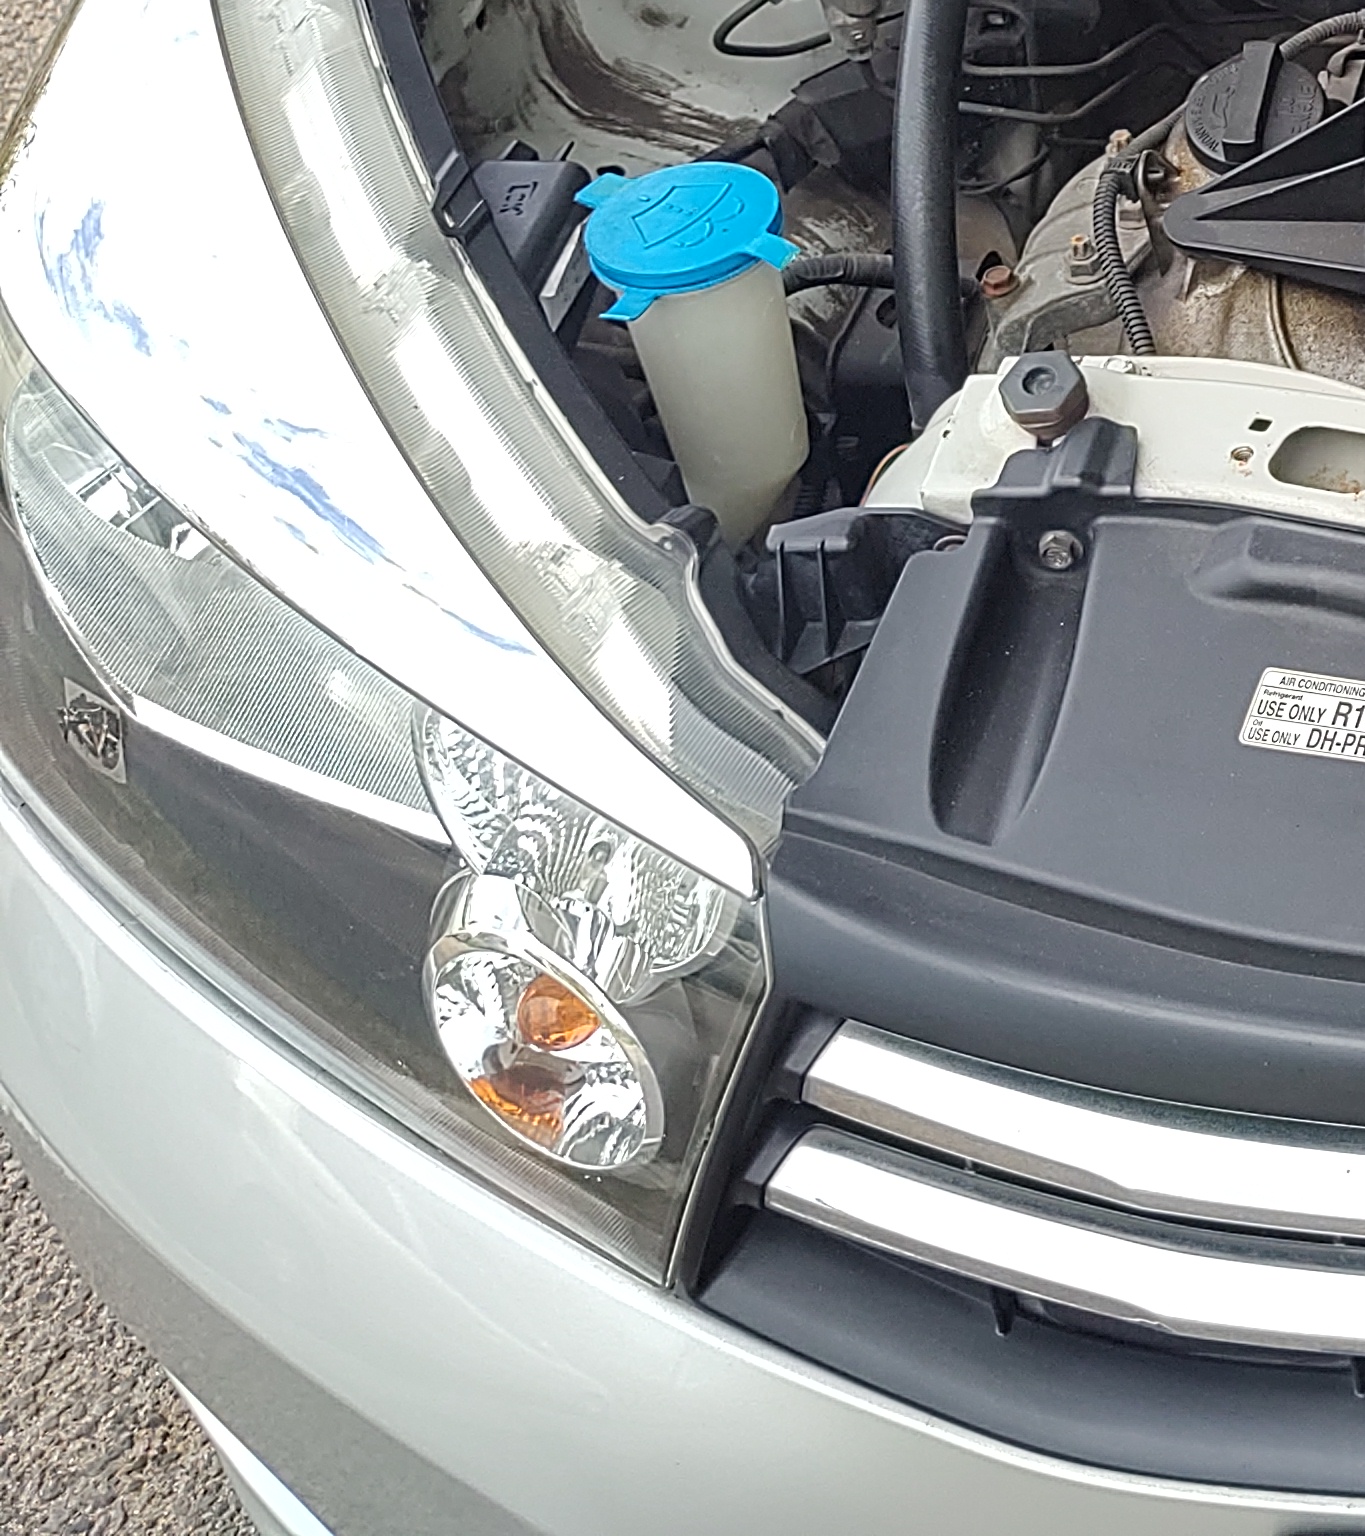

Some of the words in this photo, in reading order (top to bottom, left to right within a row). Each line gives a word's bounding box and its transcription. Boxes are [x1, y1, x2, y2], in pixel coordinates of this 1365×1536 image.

[1280, 676, 1296, 687] AIR
[1298, 679, 1365, 697] CONDITIONING
[1257, 699, 1287, 718] USE
[1289, 704, 1327, 724] ONLY
[1247, 727, 1270, 742] USE
[1272, 730, 1300, 745] ONLY
